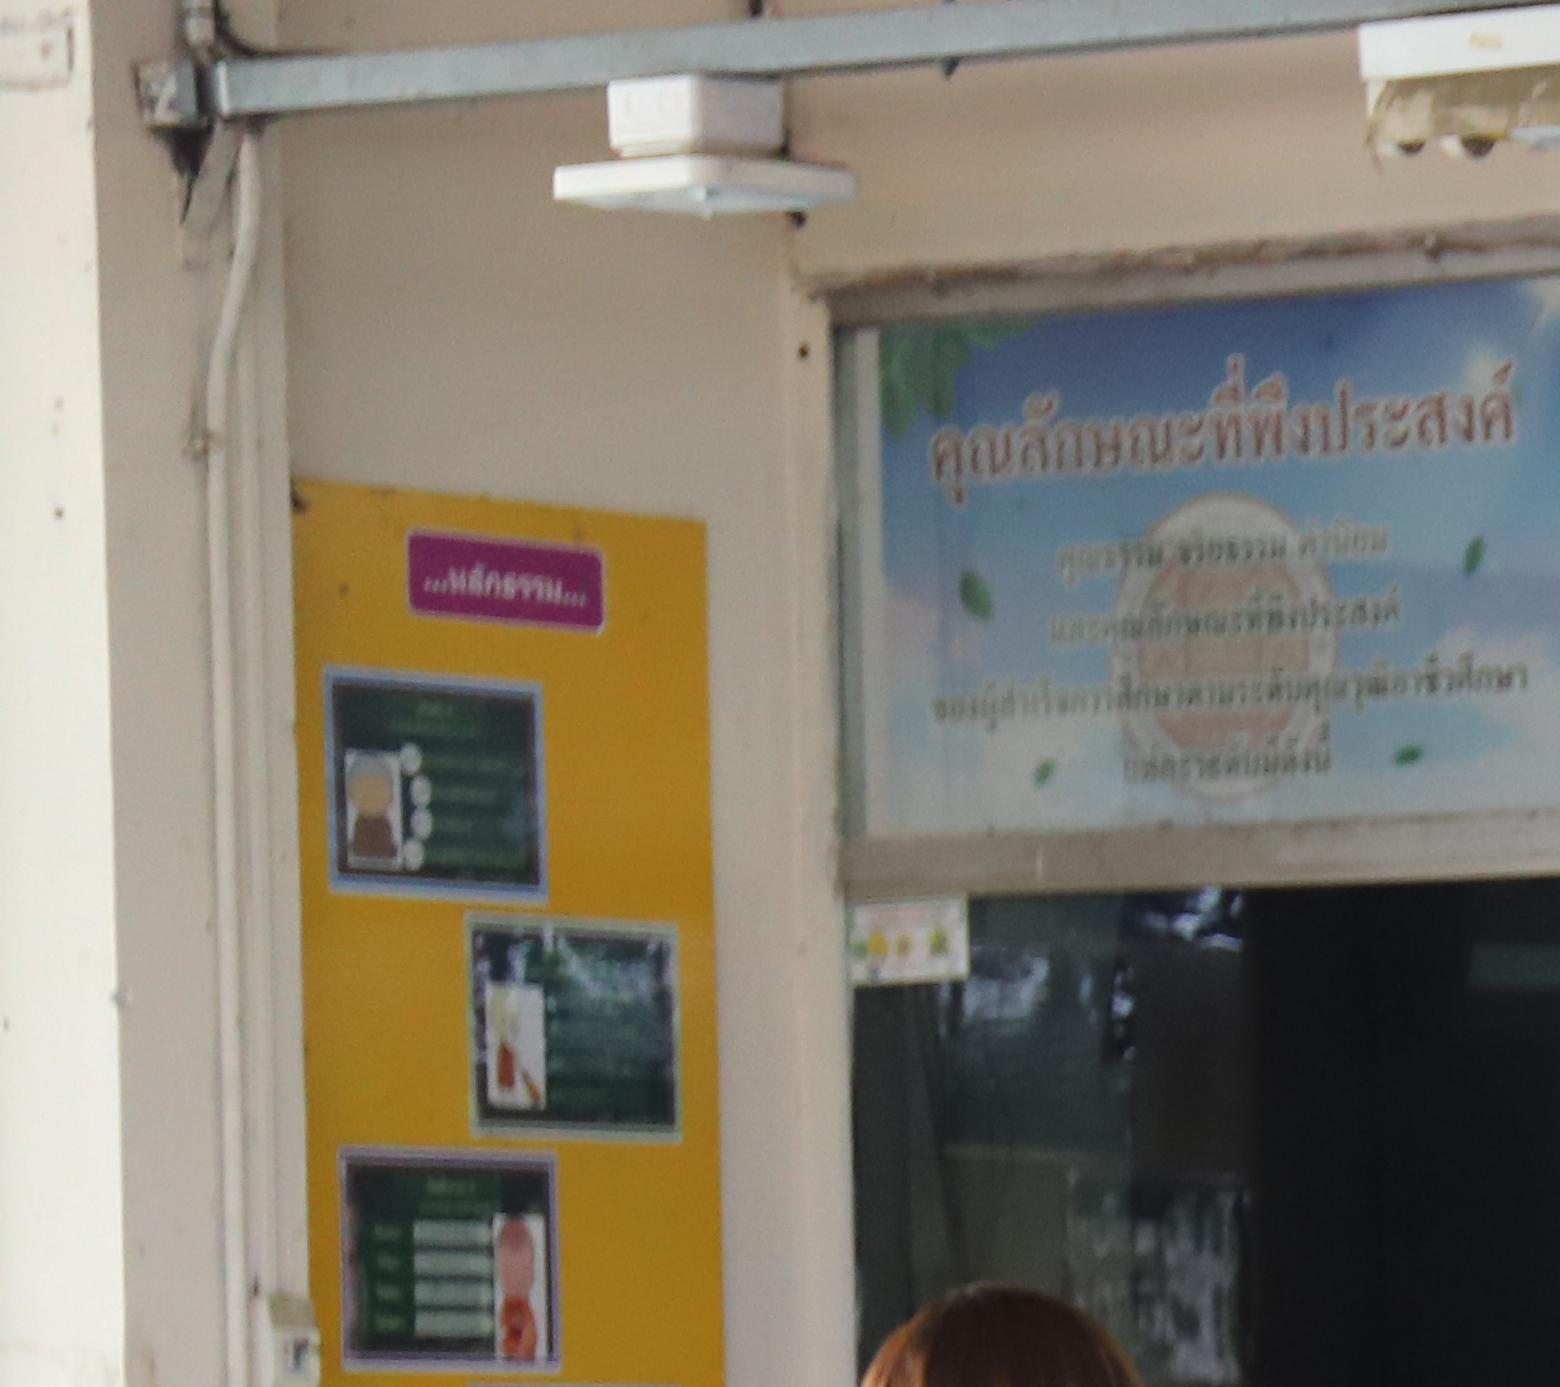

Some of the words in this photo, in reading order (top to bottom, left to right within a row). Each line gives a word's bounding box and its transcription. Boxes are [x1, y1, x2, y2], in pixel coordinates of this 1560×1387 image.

[932, 354, 1515, 507] คุณลักษณะที่พึงประสงค์
